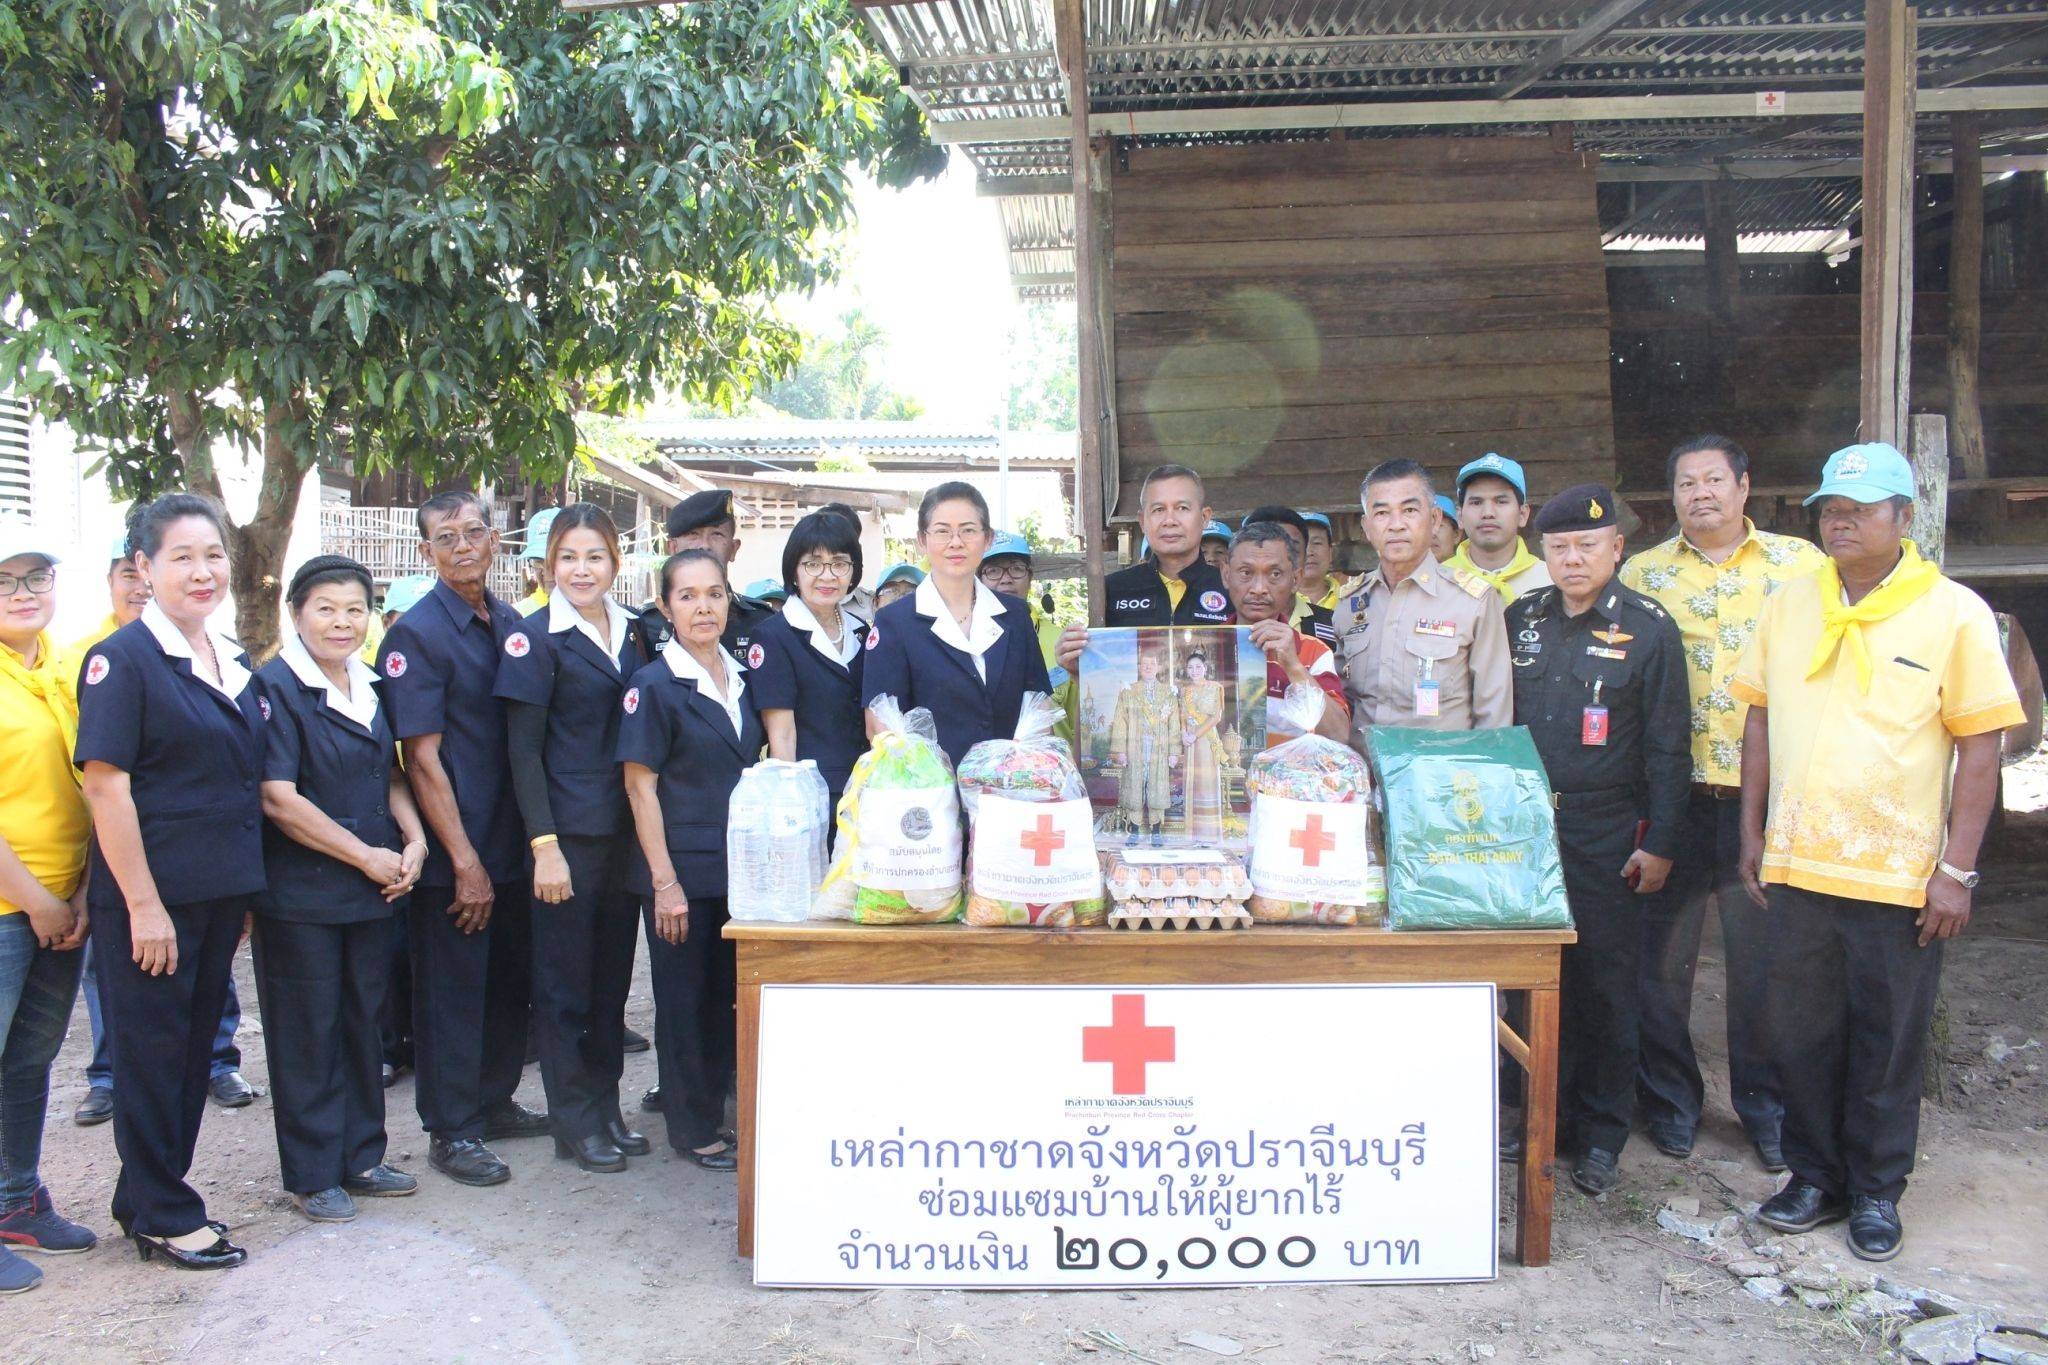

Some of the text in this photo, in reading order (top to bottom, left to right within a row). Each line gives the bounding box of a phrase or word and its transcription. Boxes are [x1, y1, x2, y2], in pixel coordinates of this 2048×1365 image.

[1116, 598, 1151, 610] ISOC
[1464, 851, 1488, 864] THAI
[1064, 1096, 1194, 1109] เหล่ากาชาดจังหวัดปราจีนบุรี
[830, 1121, 1427, 1181] เหล่ากาชาดจังหวัดปราจีนบุรี
[918, 1172, 1344, 1231] ซ่อมแซมบ้านให้ผู้ยากไร้
[837, 1225, 1420, 1280] จำนวนเงิน ๒๐,๐๐๐ บาท
